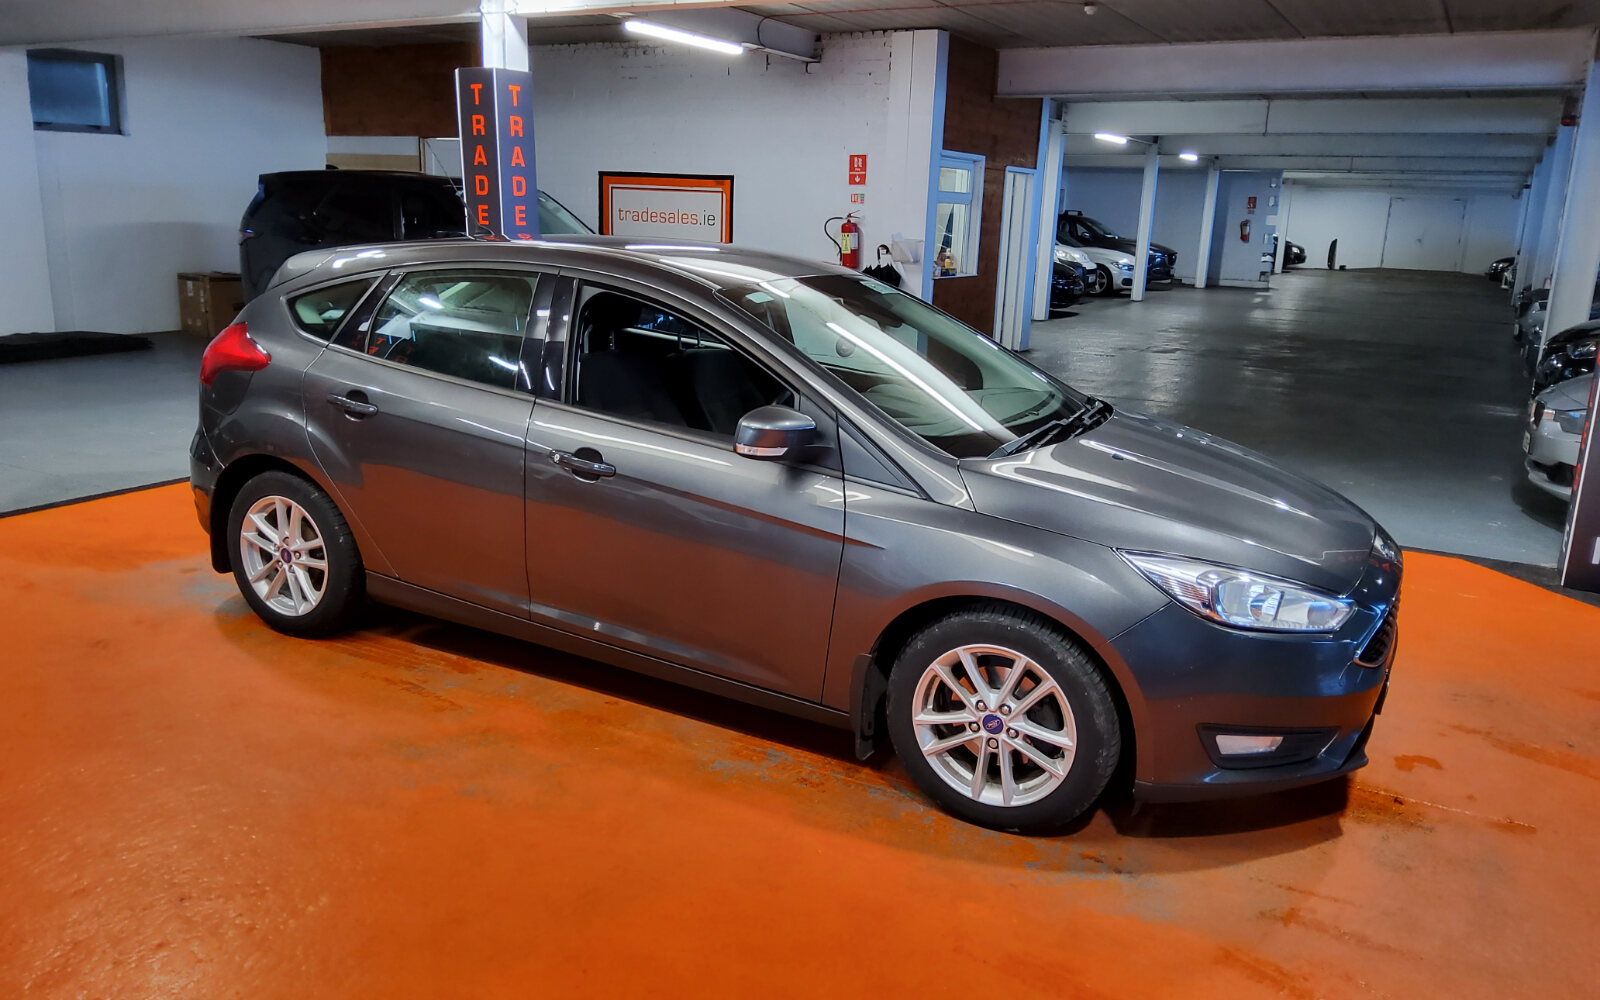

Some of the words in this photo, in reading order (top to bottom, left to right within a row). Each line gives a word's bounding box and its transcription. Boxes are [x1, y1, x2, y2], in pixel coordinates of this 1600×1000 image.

[470, 83, 489, 225] TRADE
[508, 85, 527, 226] TRADE
[618, 207, 716, 226] tradesales.ie
